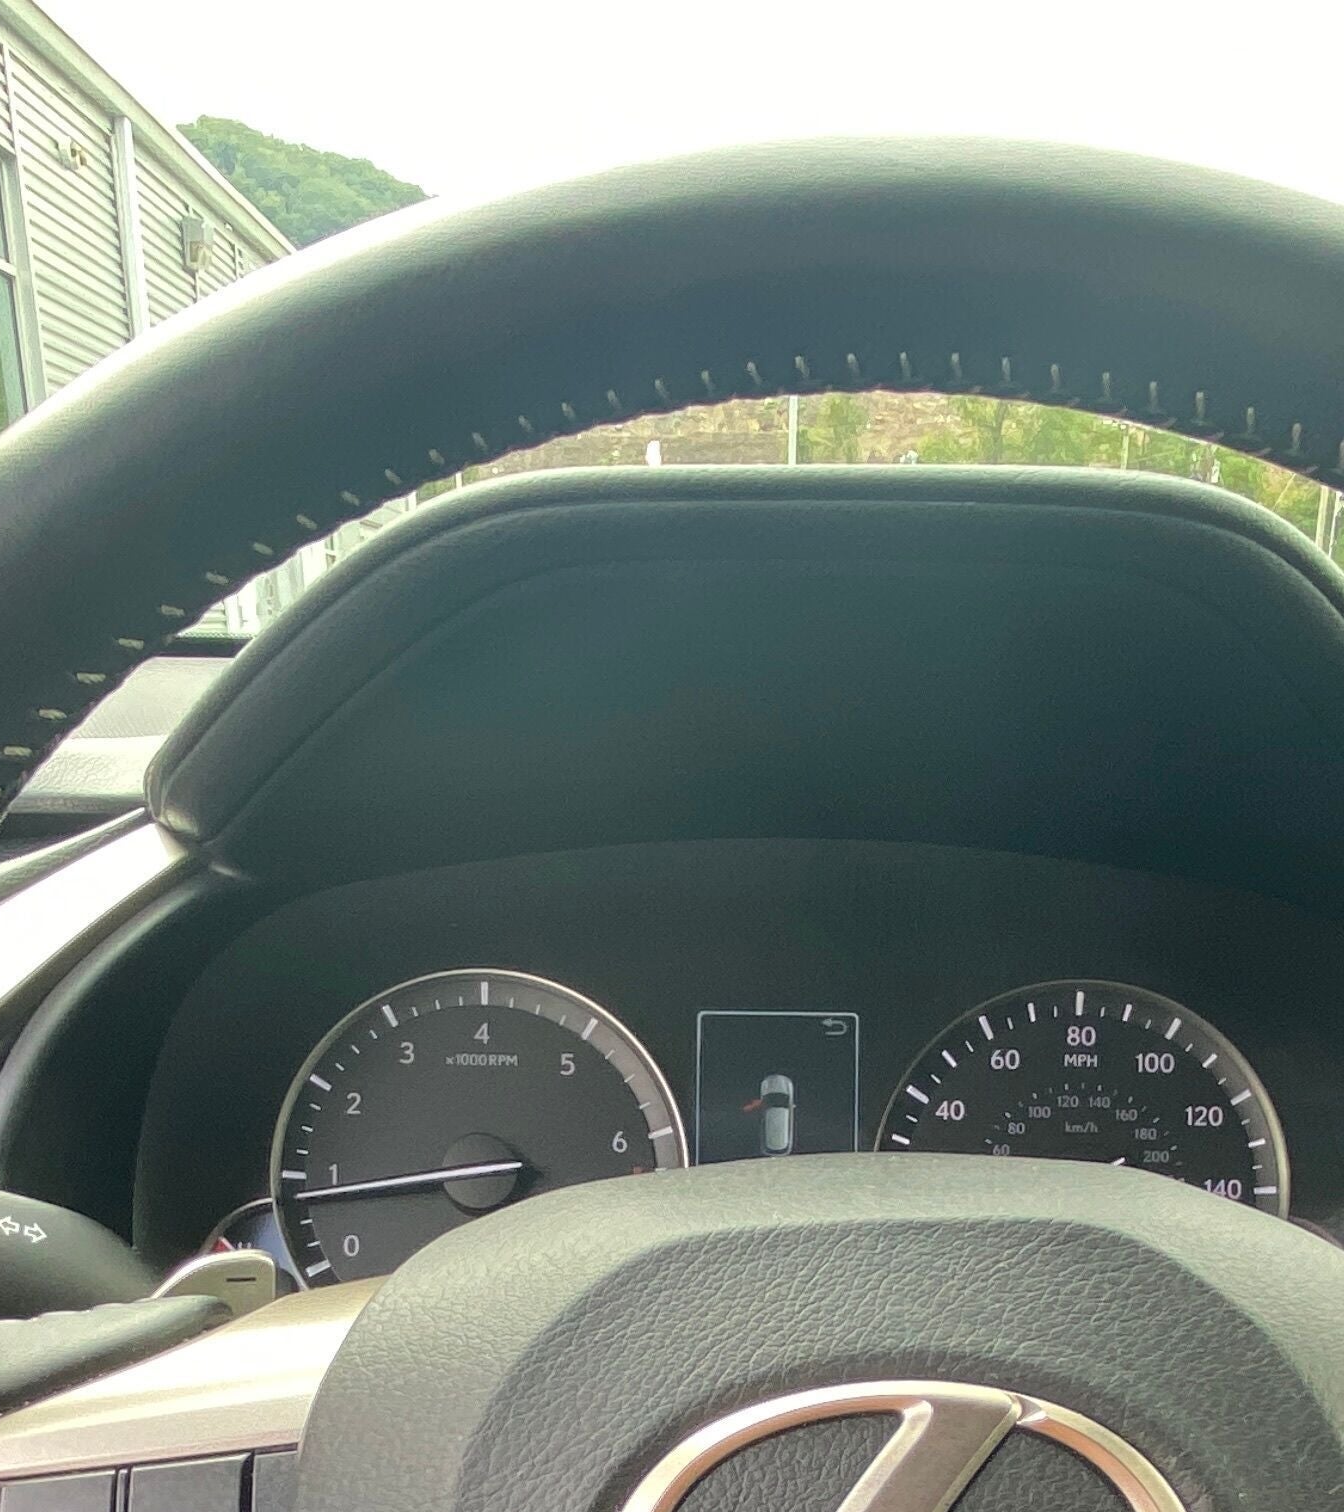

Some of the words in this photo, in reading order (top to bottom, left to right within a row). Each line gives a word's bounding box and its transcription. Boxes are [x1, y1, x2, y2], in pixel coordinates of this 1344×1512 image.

[472, 1021, 491, 1045] 4
[1065, 1025, 1098, 1048] 80
[398, 1040, 416, 1066] 3
[989, 1048, 1021, 1071] 60
[1062, 1052, 1099, 1069] MPH
[1134, 1051, 1176, 1075] 100
[559, 1053, 576, 1077] 5
[345, 1092, 363, 1116] 2
[934, 1099, 966, 1122] 40
[1027, 1106, 1052, 1119] 100
[1057, 1095, 1080, 1108] 120
[1088, 1096, 1112, 1109] 140
[1064, 1120, 1099, 1135] km/h
[1184, 1104, 1225, 1128] 120
[1007, 1122, 1026, 1136] 80
[610, 1130, 628, 1154] 6
[1143, 1150, 1170, 1164] 200
[328, 1164, 341, 1185] 1
[1204, 1178, 1244, 1200] 140
[342, 1234, 361, 1258] 0
